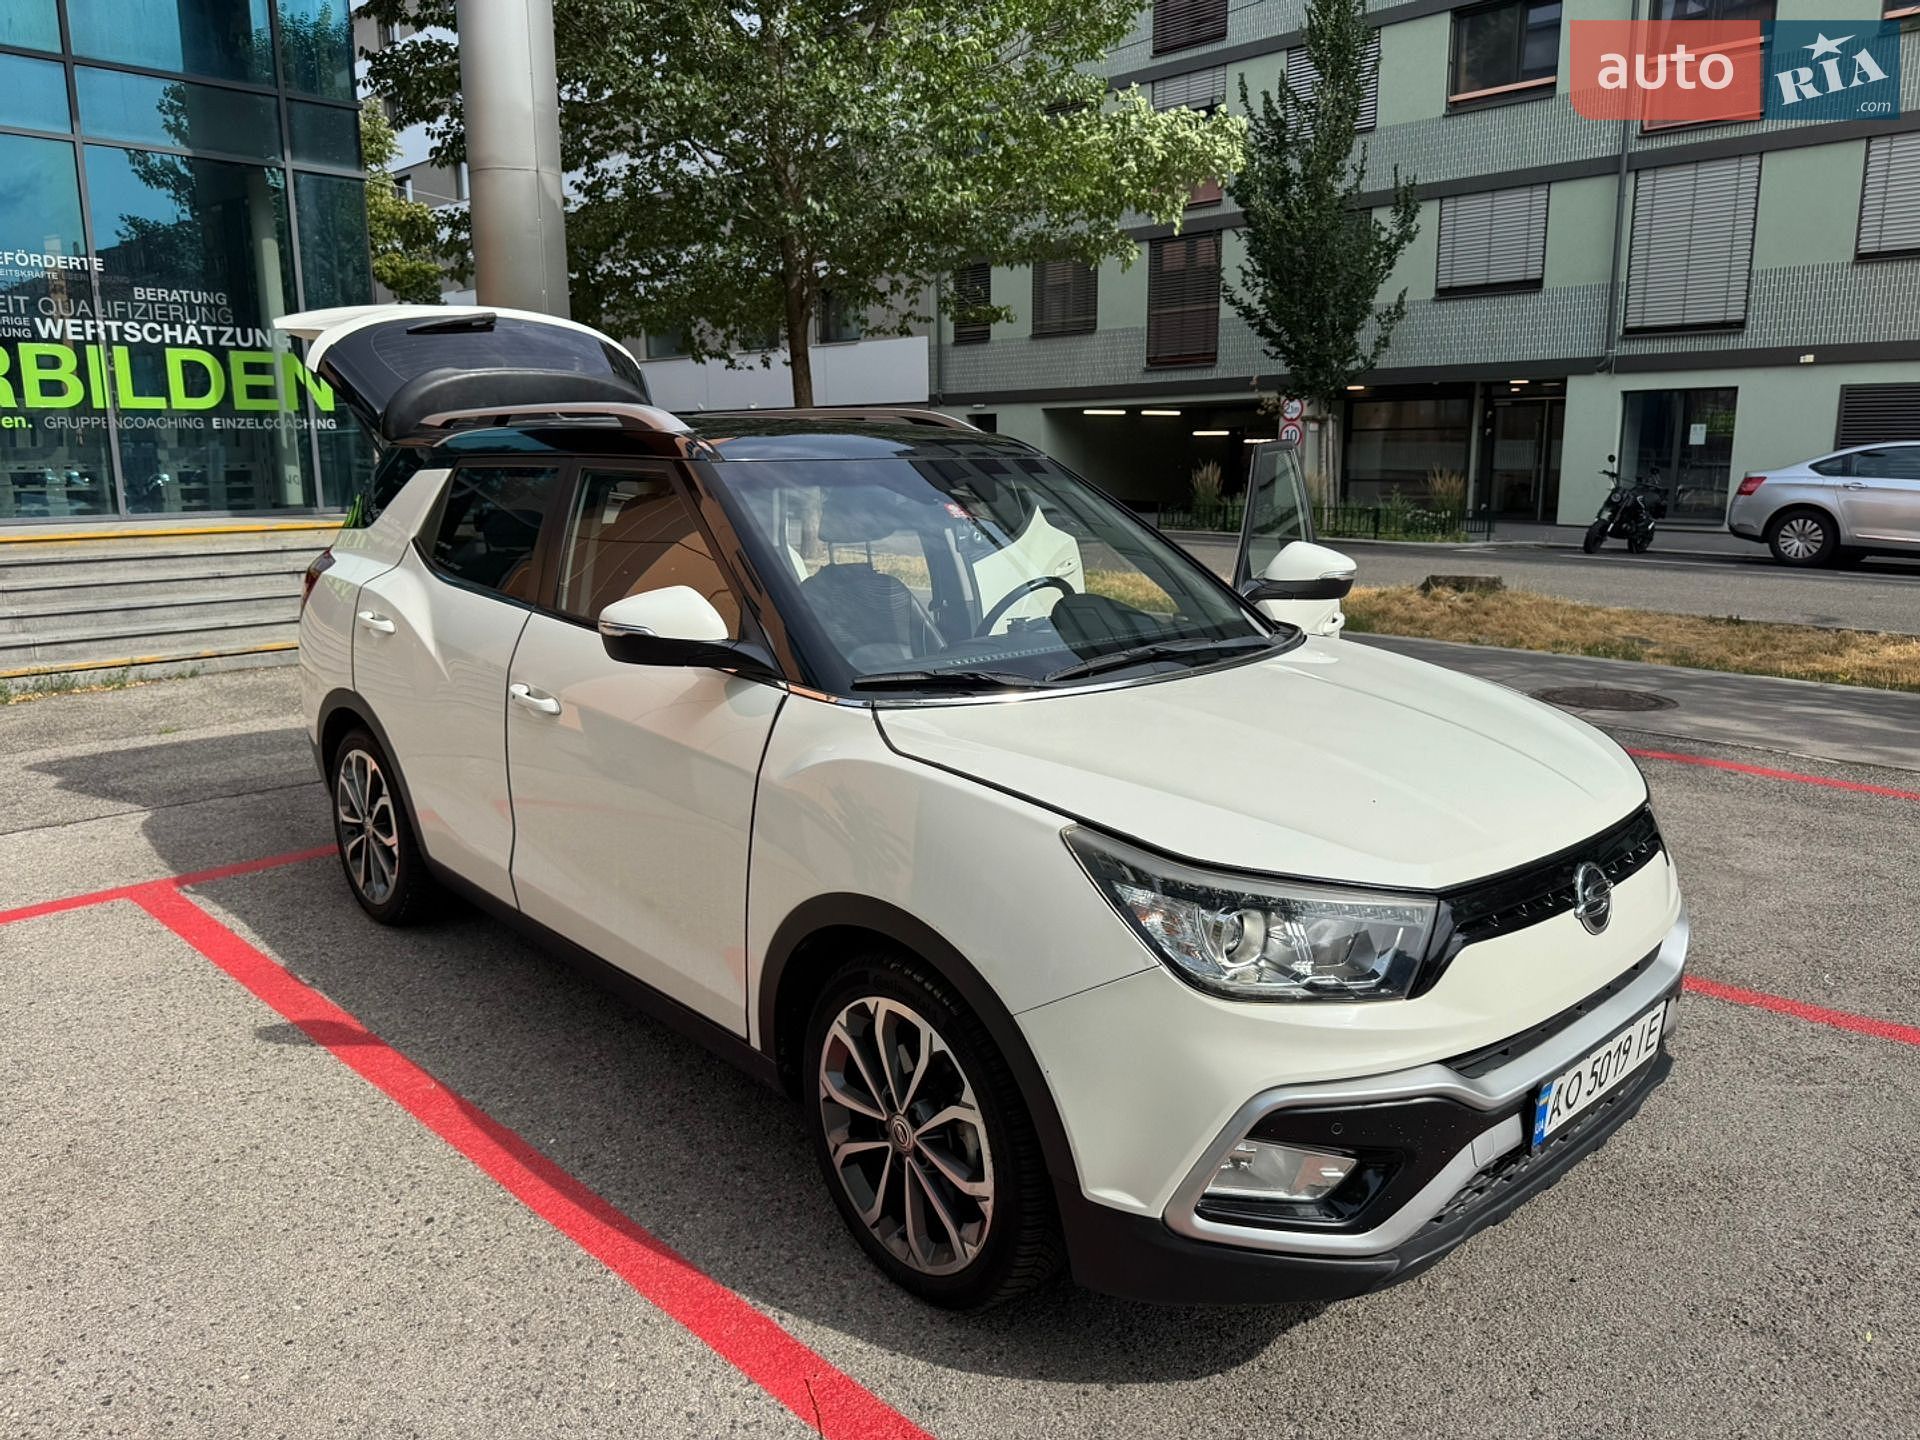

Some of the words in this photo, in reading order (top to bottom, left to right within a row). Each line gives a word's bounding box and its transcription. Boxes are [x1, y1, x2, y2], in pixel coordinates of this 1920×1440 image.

[37, 296, 235, 325] QUALIFIZIERUNG
[133, 286, 228, 306] BERATUNG
[34, 317, 293, 348] WERTSCHÄTZUNG
[0, 342, 335, 413] BILDEN
[43, 416, 205, 430] GRUPPENCOACHING
[212, 416, 337, 430] EINZELCOACHING
[1285, 428, 1298, 441] 10
[1550, 1070, 1583, 1124] AO
[1586, 1034, 1633, 1097] 5019
[1637, 1011, 1661, 1060] IE
